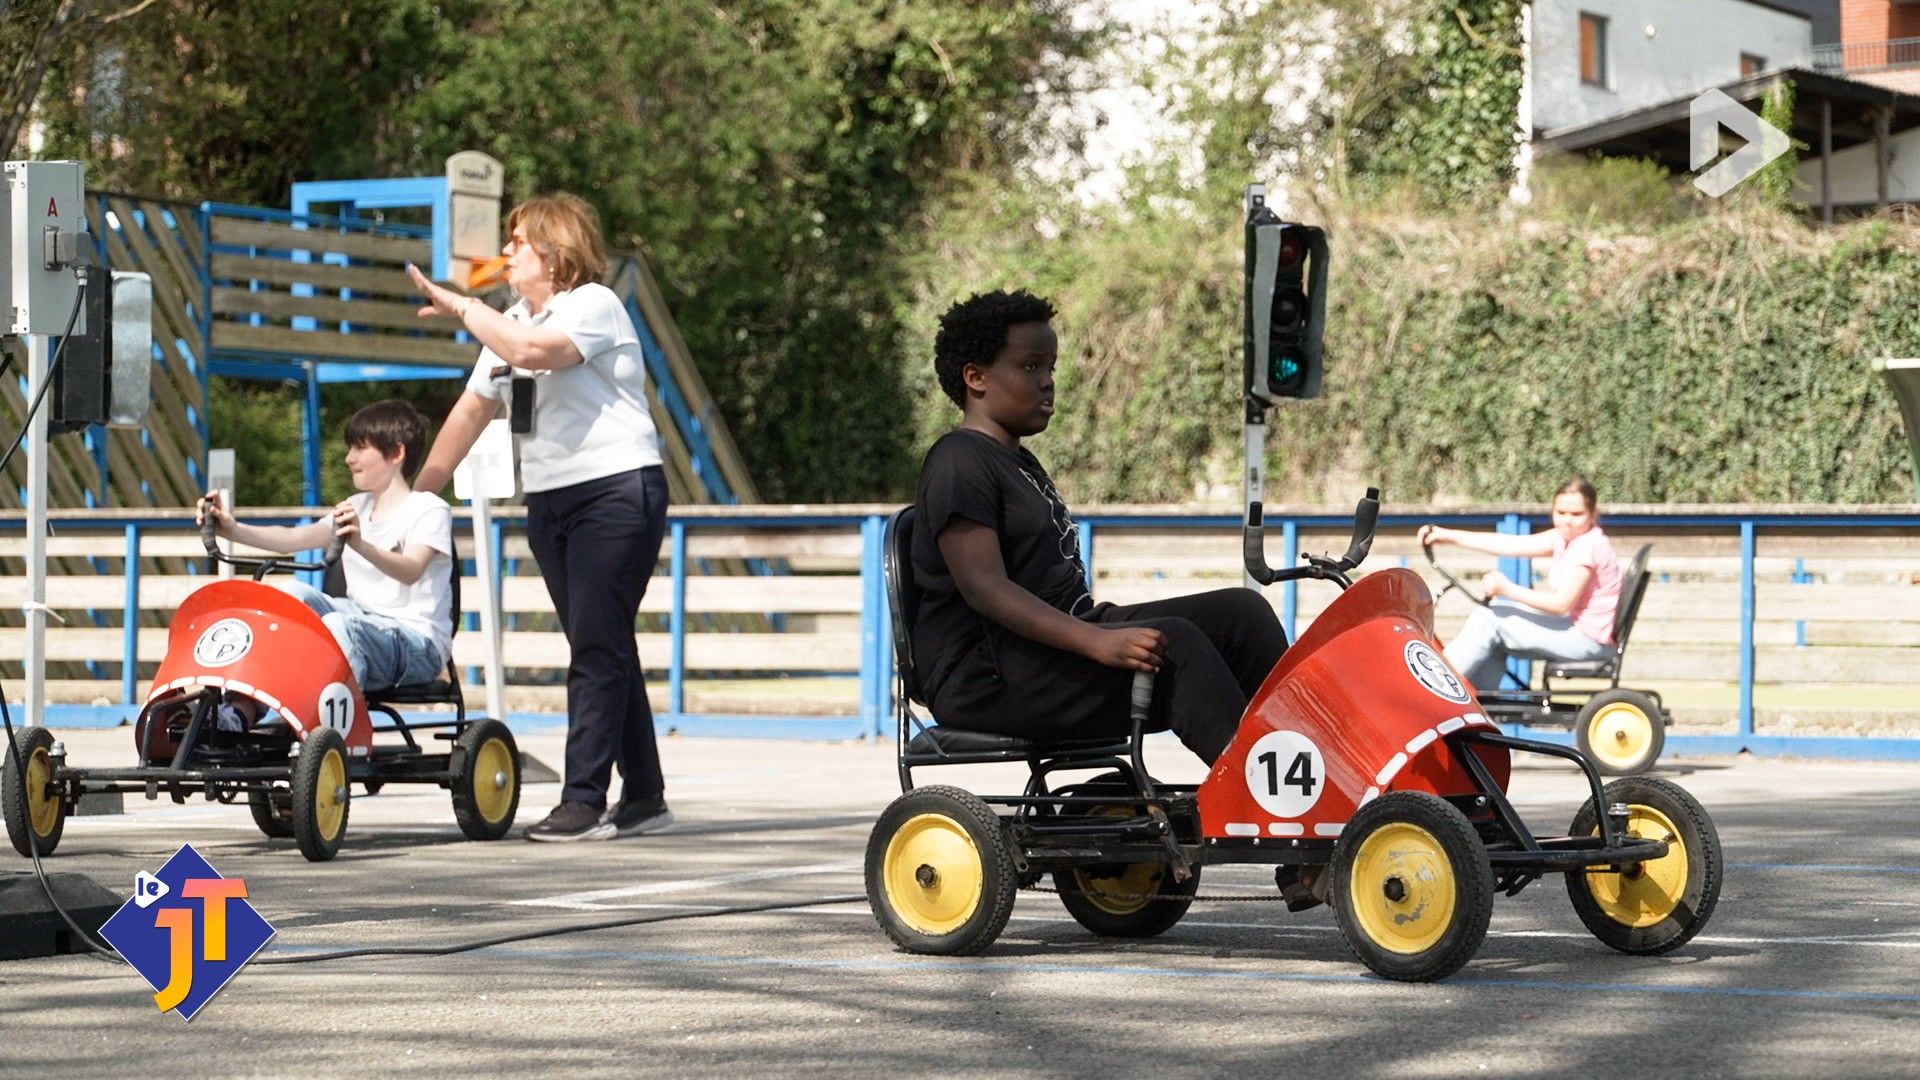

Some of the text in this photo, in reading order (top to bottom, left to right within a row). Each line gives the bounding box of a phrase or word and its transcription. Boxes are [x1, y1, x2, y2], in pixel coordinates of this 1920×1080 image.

[47, 197, 58, 217] A
[325, 697, 348, 729] 11
[1258, 751, 1316, 796] 14
